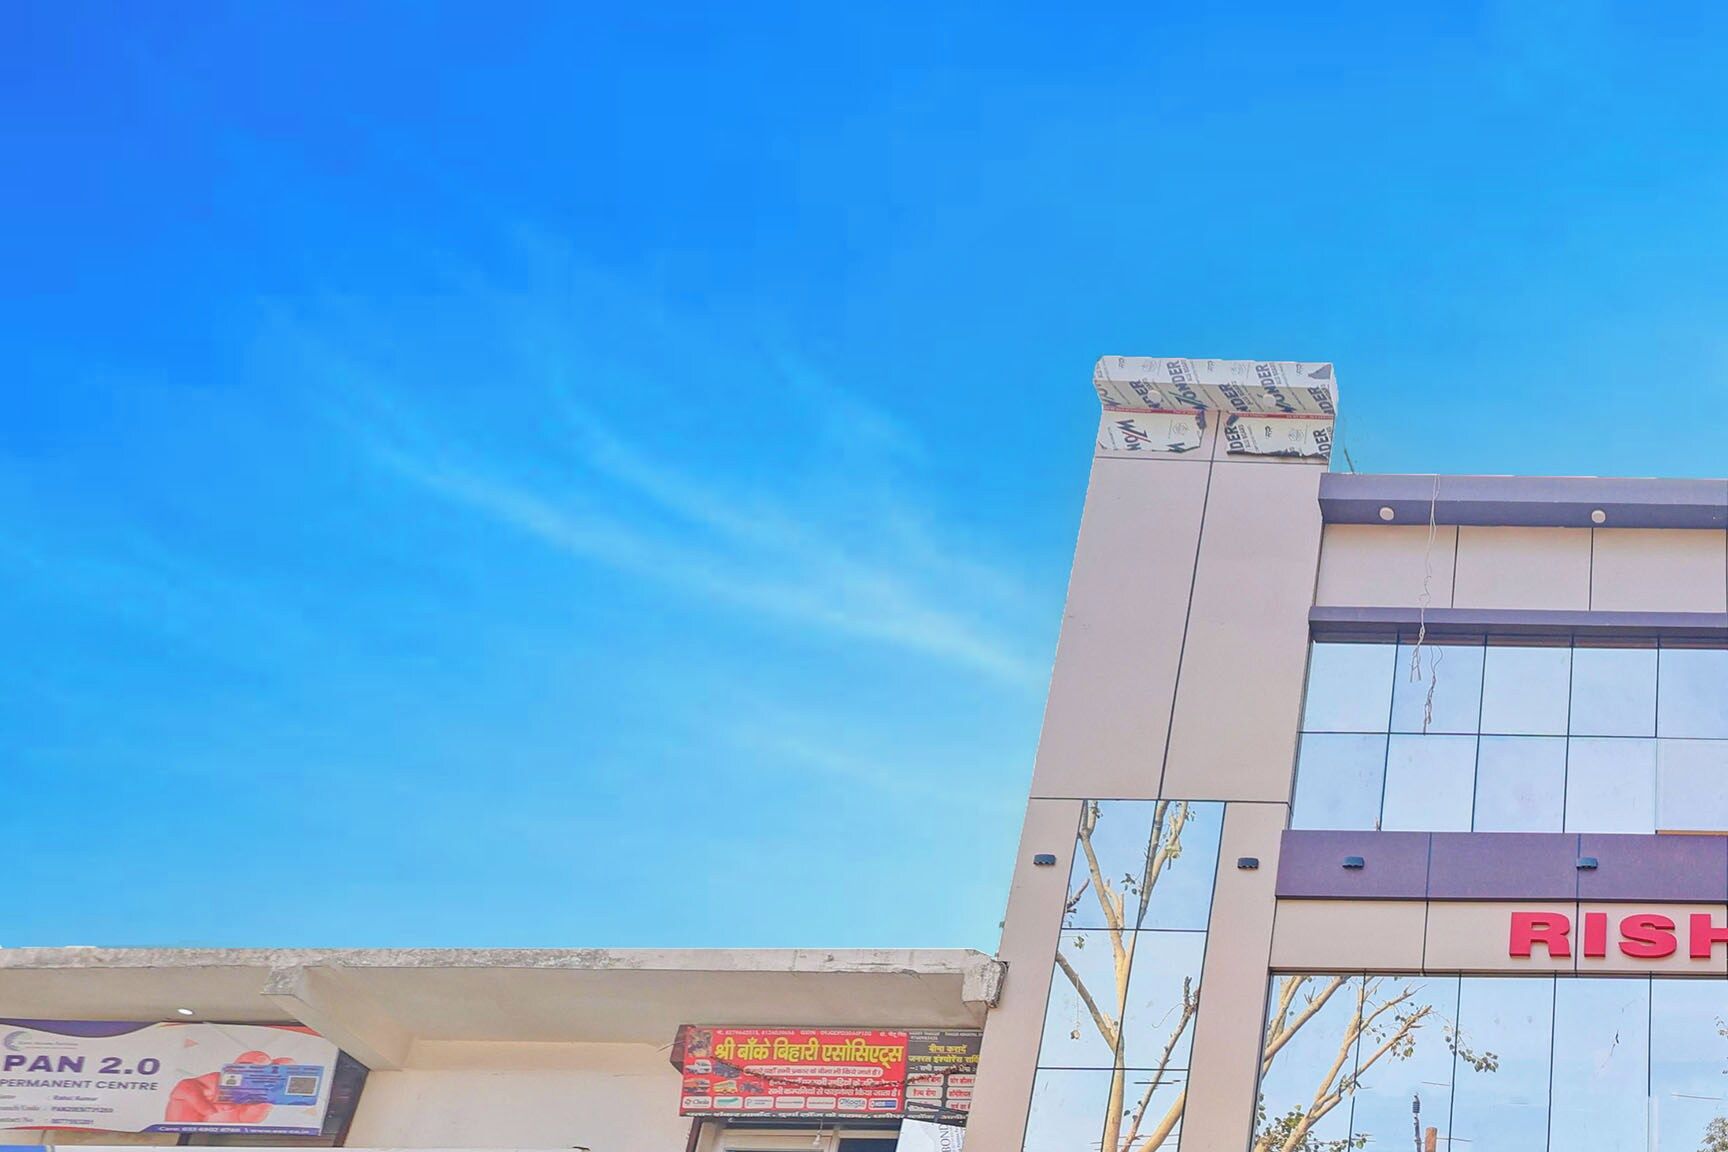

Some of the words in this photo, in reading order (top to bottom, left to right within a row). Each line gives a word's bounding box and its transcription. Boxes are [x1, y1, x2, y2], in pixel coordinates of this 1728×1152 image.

[714, 1036, 735, 1060] श्री
[3, 1055, 85, 1074] PAN
[100, 1056, 160, 1076] 2.0
[0, 1077, 92, 1089] PERMANENT
[98, 1080, 159, 1091] CENTRE
